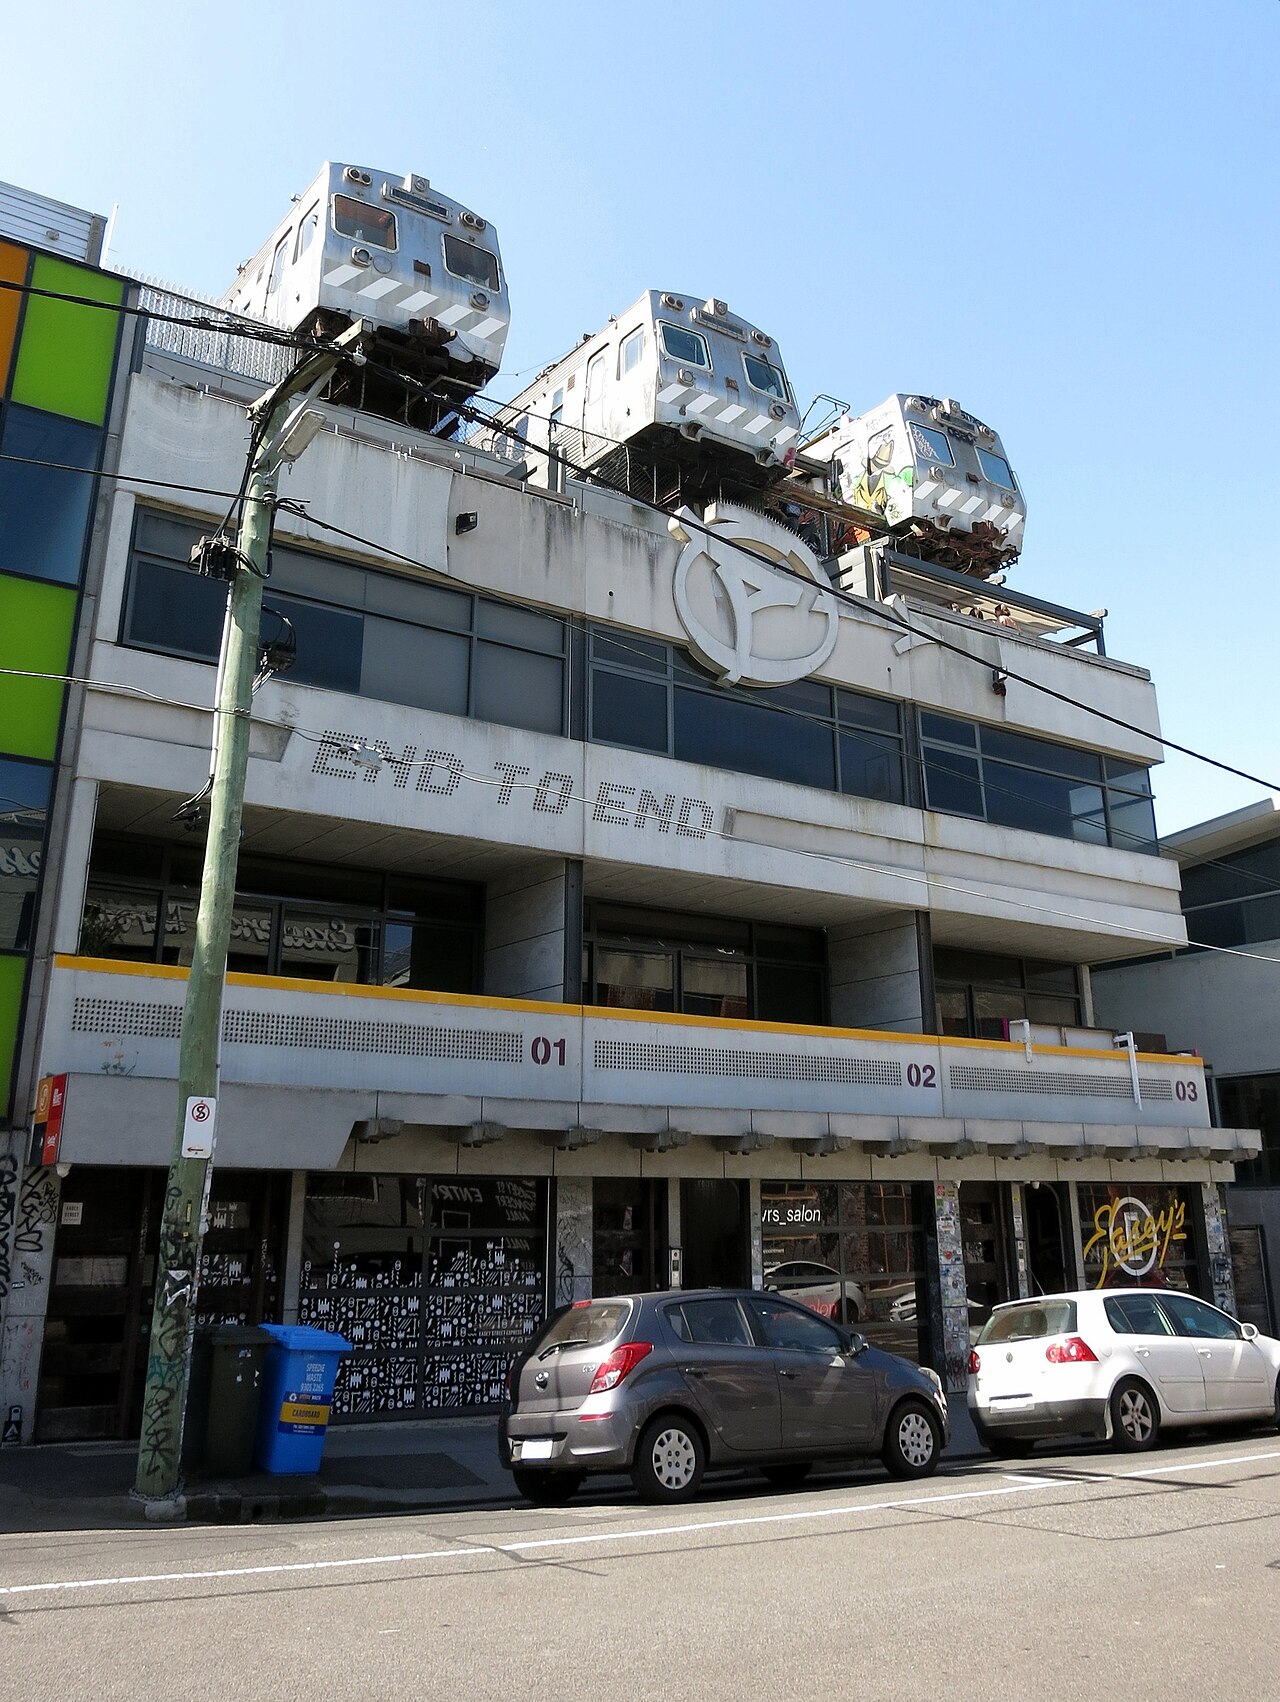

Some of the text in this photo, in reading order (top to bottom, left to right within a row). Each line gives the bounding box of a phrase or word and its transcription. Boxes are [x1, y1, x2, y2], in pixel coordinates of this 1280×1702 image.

[311, 729, 715, 840] END TO END
[531, 1036, 566, 1066] 01
[906, 1063, 936, 1088] 02
[1175, 1080, 1198, 1102] 03
